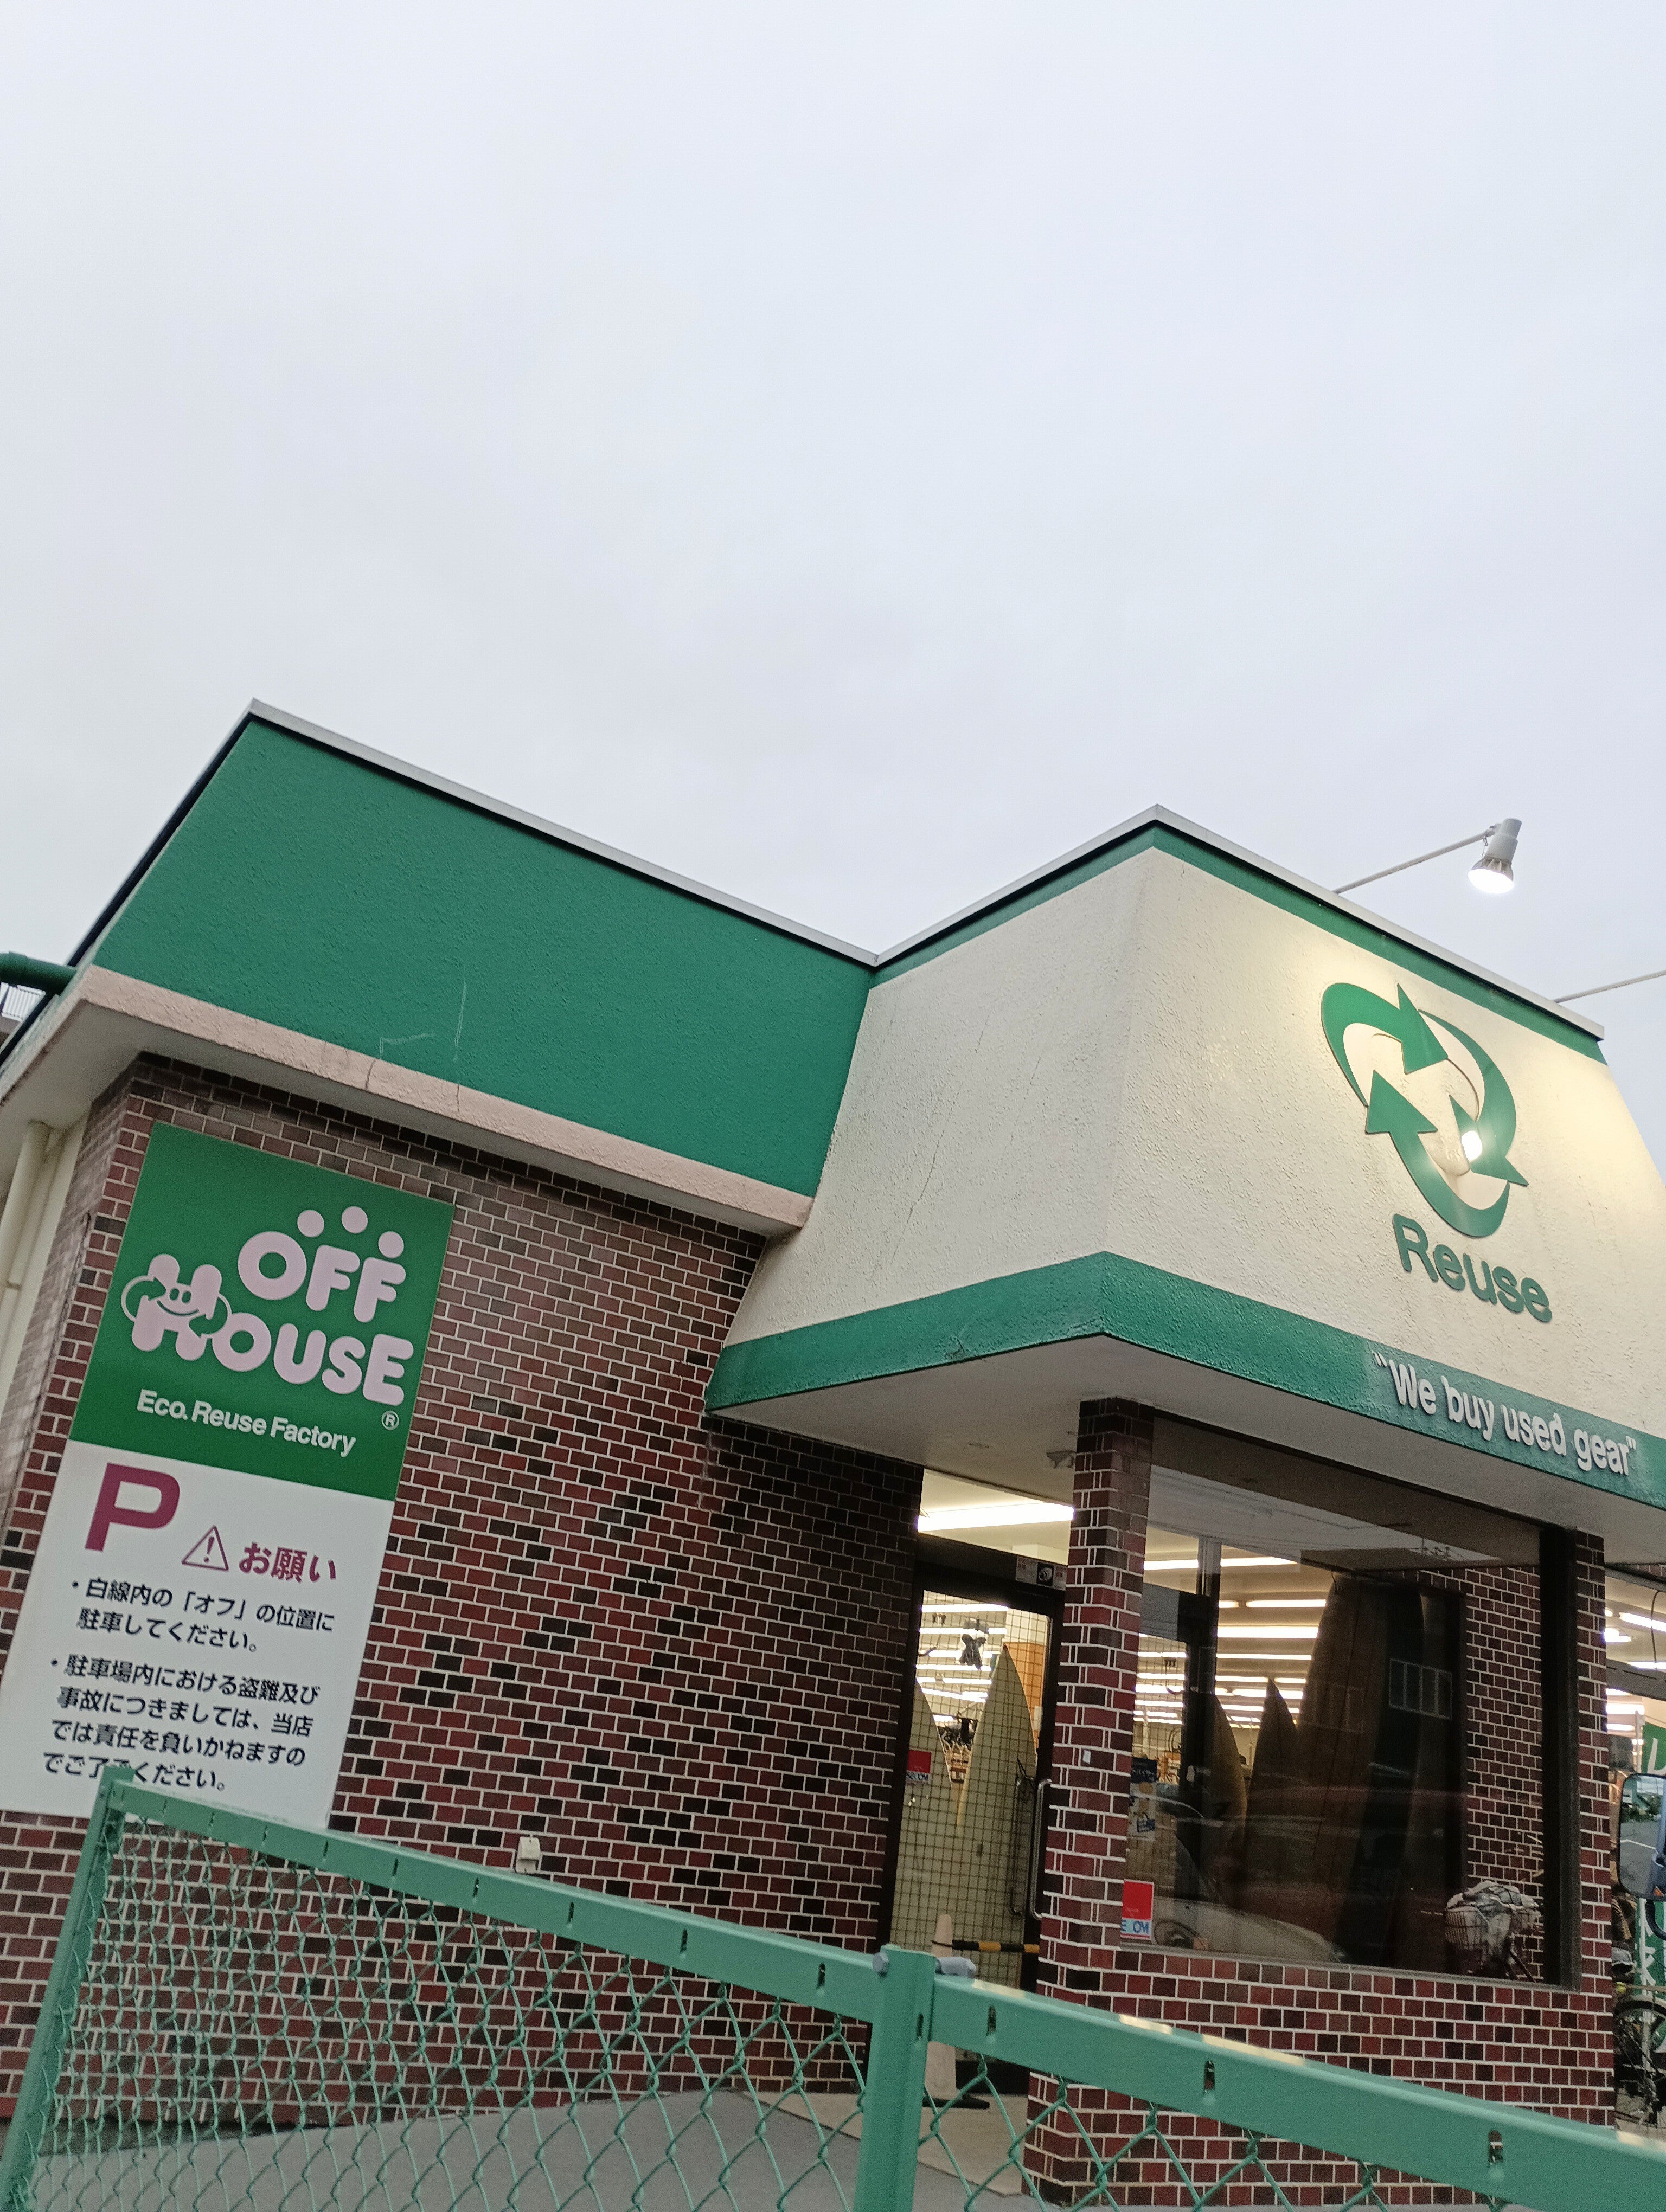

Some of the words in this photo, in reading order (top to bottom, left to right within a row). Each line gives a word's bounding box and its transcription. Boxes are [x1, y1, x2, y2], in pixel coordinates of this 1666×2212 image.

[238, 1231, 406, 1323] OFF
[1392, 1213, 1552, 1323] Reuse
[132, 1255, 414, 1406] HOUSE
[190, 1400, 267, 1436] Reuse
[270, 1416, 356, 1457] Factory
[1441, 1375, 1494, 1441] buy
[1502, 1404, 1566, 1456] used
[85, 1462, 180, 1551] P
[239, 1542, 336, 1583] お願い
[76, 1607, 257, 1652] 駐車してください。
[43, 1752, 225, 1791] でご了ください。
[52, 1719, 305, 1766] では責任を負いかねますの
